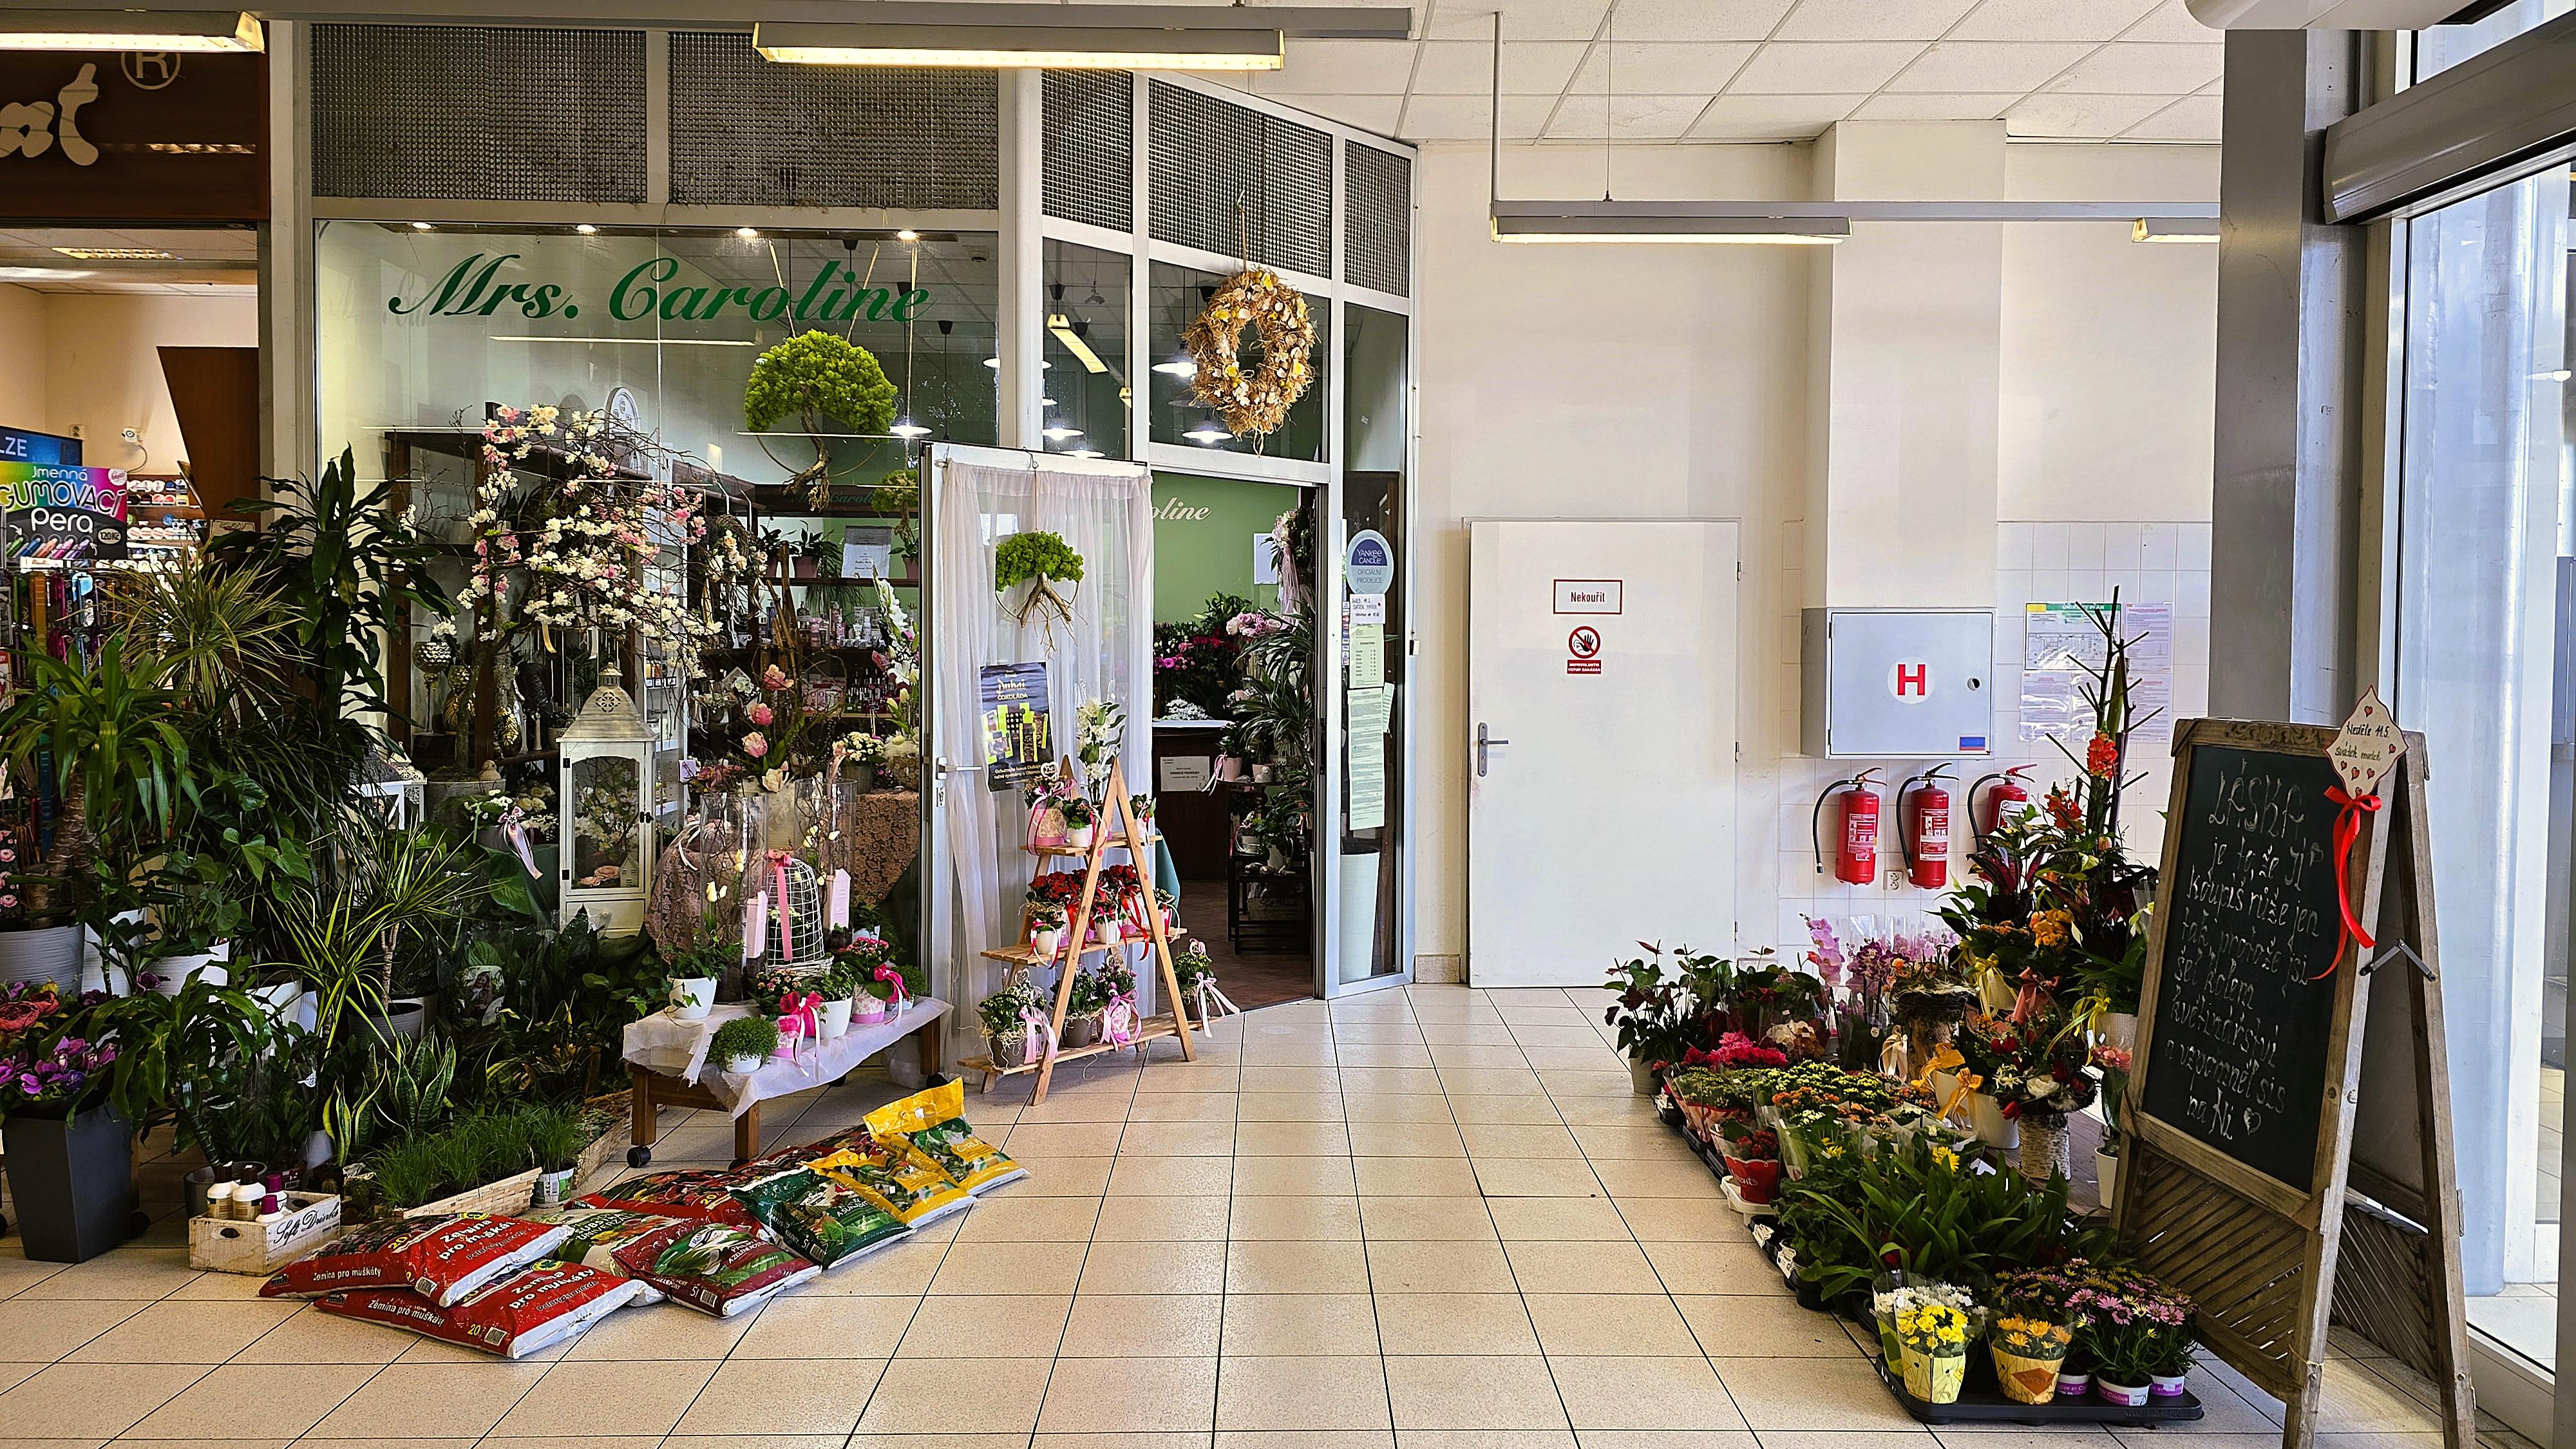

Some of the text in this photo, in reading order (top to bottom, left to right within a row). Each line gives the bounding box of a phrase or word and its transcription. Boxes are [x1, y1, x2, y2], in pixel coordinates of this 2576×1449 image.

[389, 253, 936, 323] Mrs. Caroline
[0, 436, 28, 457] ZE
[32, 466, 88, 482] Jmenná
[0, 480, 127, 518] GUMOVACÍ
[1571, 592, 1605, 602] Nekouřit
[1897, 664, 1926, 696] H
[2347, 721, 2372, 736] Neděle
[2208, 757, 2305, 840] LÁSKA
[2207, 836, 2227, 882] je
[2287, 900, 2320, 952] jen
[439, 1244, 464, 1260] pro
[337, 1269, 350, 1280] pro
[352, 1266, 381, 1277] muškáty
[509, 1293, 536, 1309] pro
[397, 1305, 410, 1316] pro
[468, 1323, 481, 1336] 20
